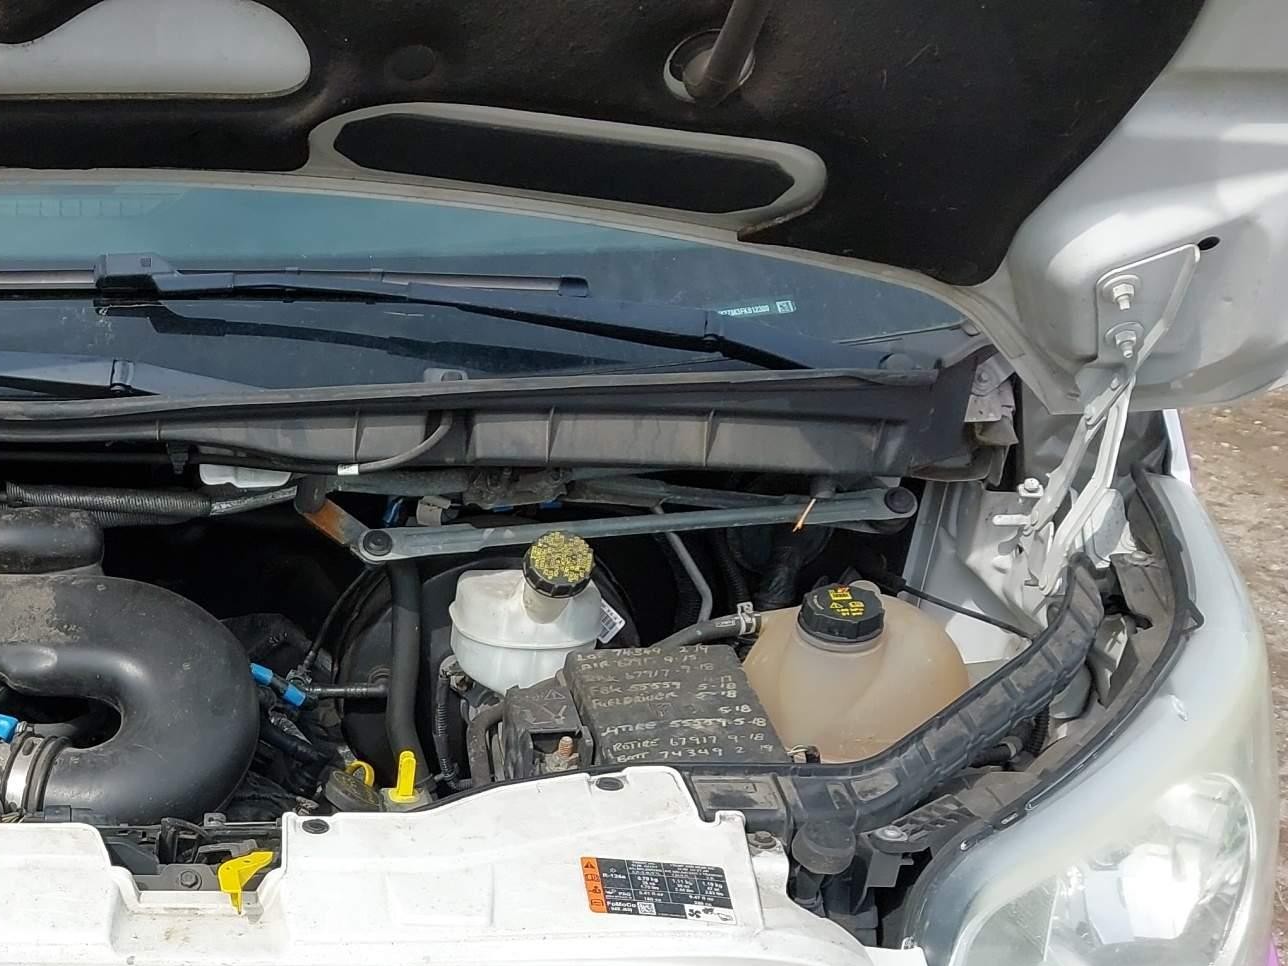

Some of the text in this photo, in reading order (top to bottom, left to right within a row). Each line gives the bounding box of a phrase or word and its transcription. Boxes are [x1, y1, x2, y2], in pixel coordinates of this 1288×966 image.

[670, 735, 718, 746] 67917
[727, 733, 765, 743] 9-18
[659, 747, 724, 760] 74349
[734, 746, 745, 754] 2
[606, 901, 637, 909] FoMoCo
